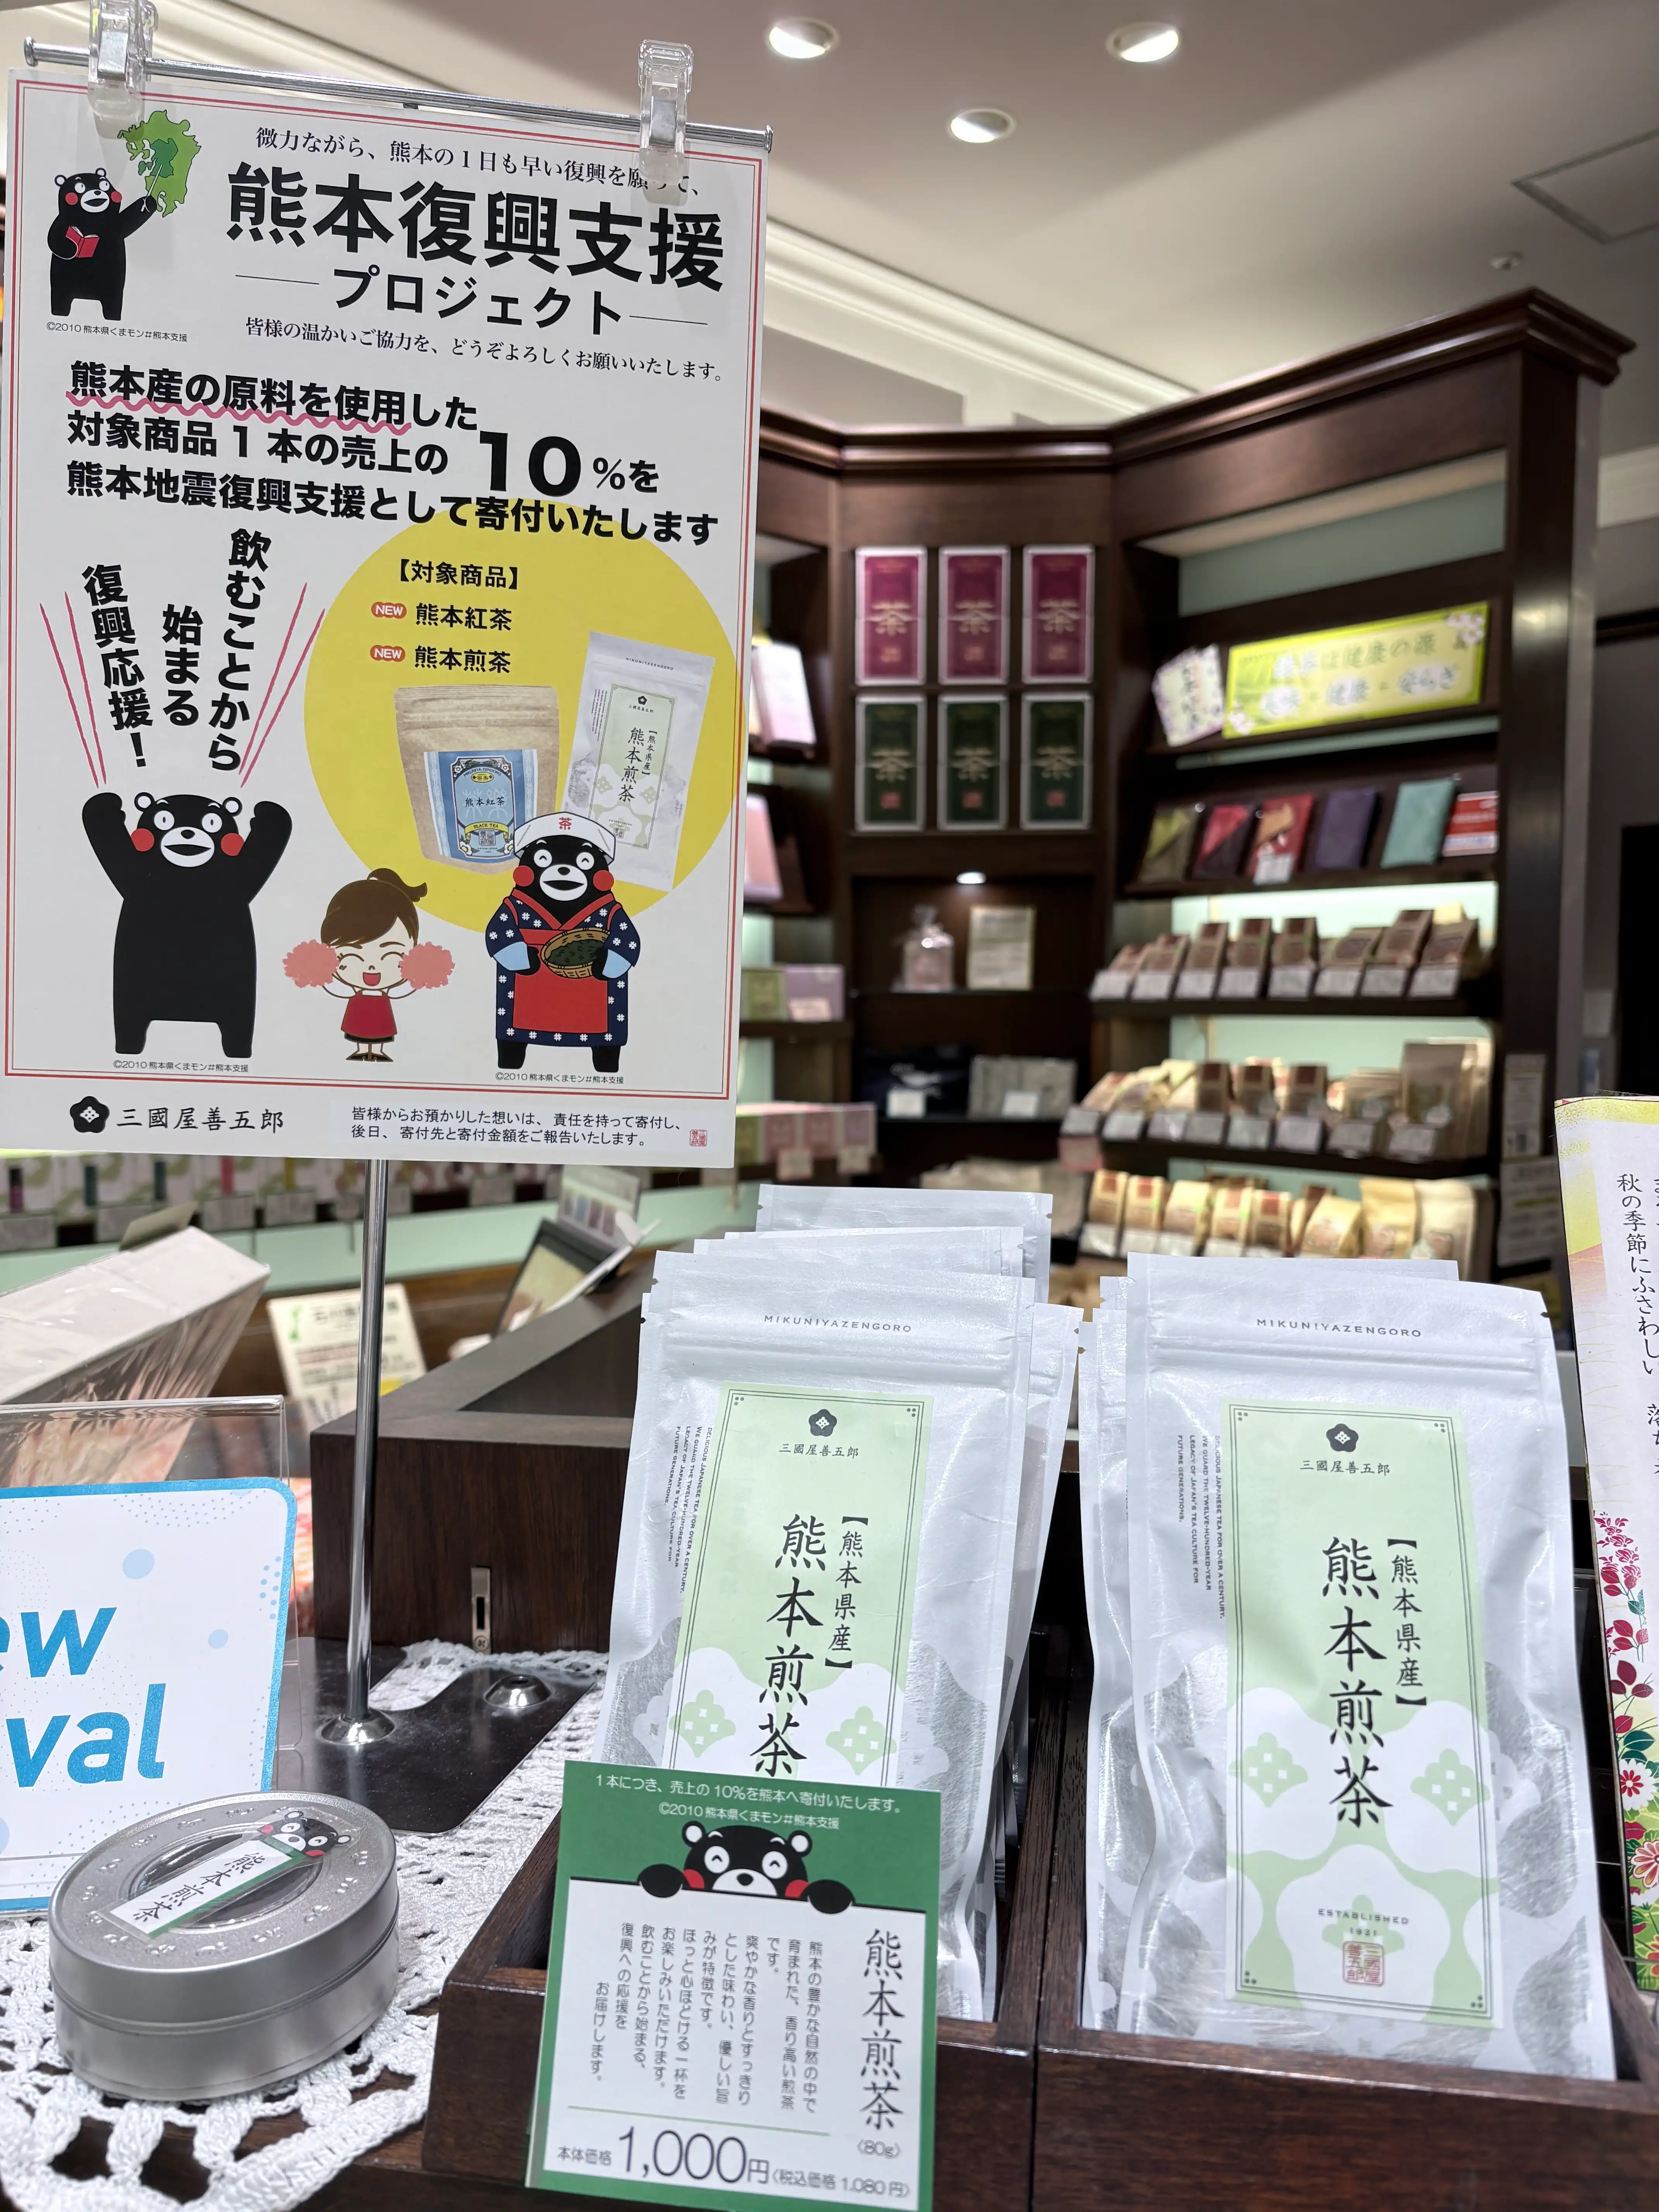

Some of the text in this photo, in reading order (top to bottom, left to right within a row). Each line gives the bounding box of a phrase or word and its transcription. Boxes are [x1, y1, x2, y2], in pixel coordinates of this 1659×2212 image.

[256, 127, 698, 195] 微力ながら、熊本の1日も早い復興を願て、
[227, 161, 724, 292] 熊本復興支援
[334, 264, 621, 335] プロジェクト
[246, 317, 721, 381] 皆様の温かいご協力を、どうぞよろしくお願いいたします。
[70, 360, 477, 430] 熊本産の原料を使用した
[67, 460, 718, 546] 熊本地震復興支援として寄付いたします
[400, 558, 519, 590] 【対象商品】
[375, 604, 404, 617] NEW
[416, 603, 512, 631] 熊本紅茶
[81, 564, 153, 768] 復興応援!
[161, 603, 204, 726] 始まる
[208, 528, 272, 771] 飲むことから
[374, 648, 402, 660] NEW
[415, 645, 511, 673] 熊本煎茶
[617, 726, 645, 802] 熊本煎茶
[465, 797, 505, 807] 熊本紅茶
[559, 817, 572, 830] 茶
[117, 1106, 284, 1134] 三國屋善五郎
[351, 1106, 680, 1130] 皆様からお預かりした想いは、責任を持って寄付し、
[351, 1124, 645, 1147] 後日、寄付先と寄付金額をご報告いたします。
[764, 1314, 912, 1333] MIKUNIYAZENGORO
[1257, 1318, 1422, 1339] MIKUNIYAZENGORO
[695, 1426, 702, 1438] WE
[702, 1427, 712, 1462] DELICIOUS
[778, 1443, 860, 1460] 三國屋善五郎
[1299, 1460, 1391, 1477] 三國屋善五郎
[696, 1463, 706, 1498] JAPANESE
[1190, 1465, 1196, 1475] OF
[680, 1558, 689, 1593] CENTURY.
[825, 1516, 869, 1669] 【熊本県産】
[1387, 1538, 1427, 1706] 【熊本県産】
[750, 1514, 826, 1777] 熊本煎茶
[1321, 1537, 1394, 1828] 熊本煎茶
[132, 1851, 265, 1922] 熊本煎茶
[1318, 1908, 1410, 1925] ESTABLISHED
[859, 1928, 905, 2131] 熊本煎茶
[558, 2145, 612, 2166] 本体価格
